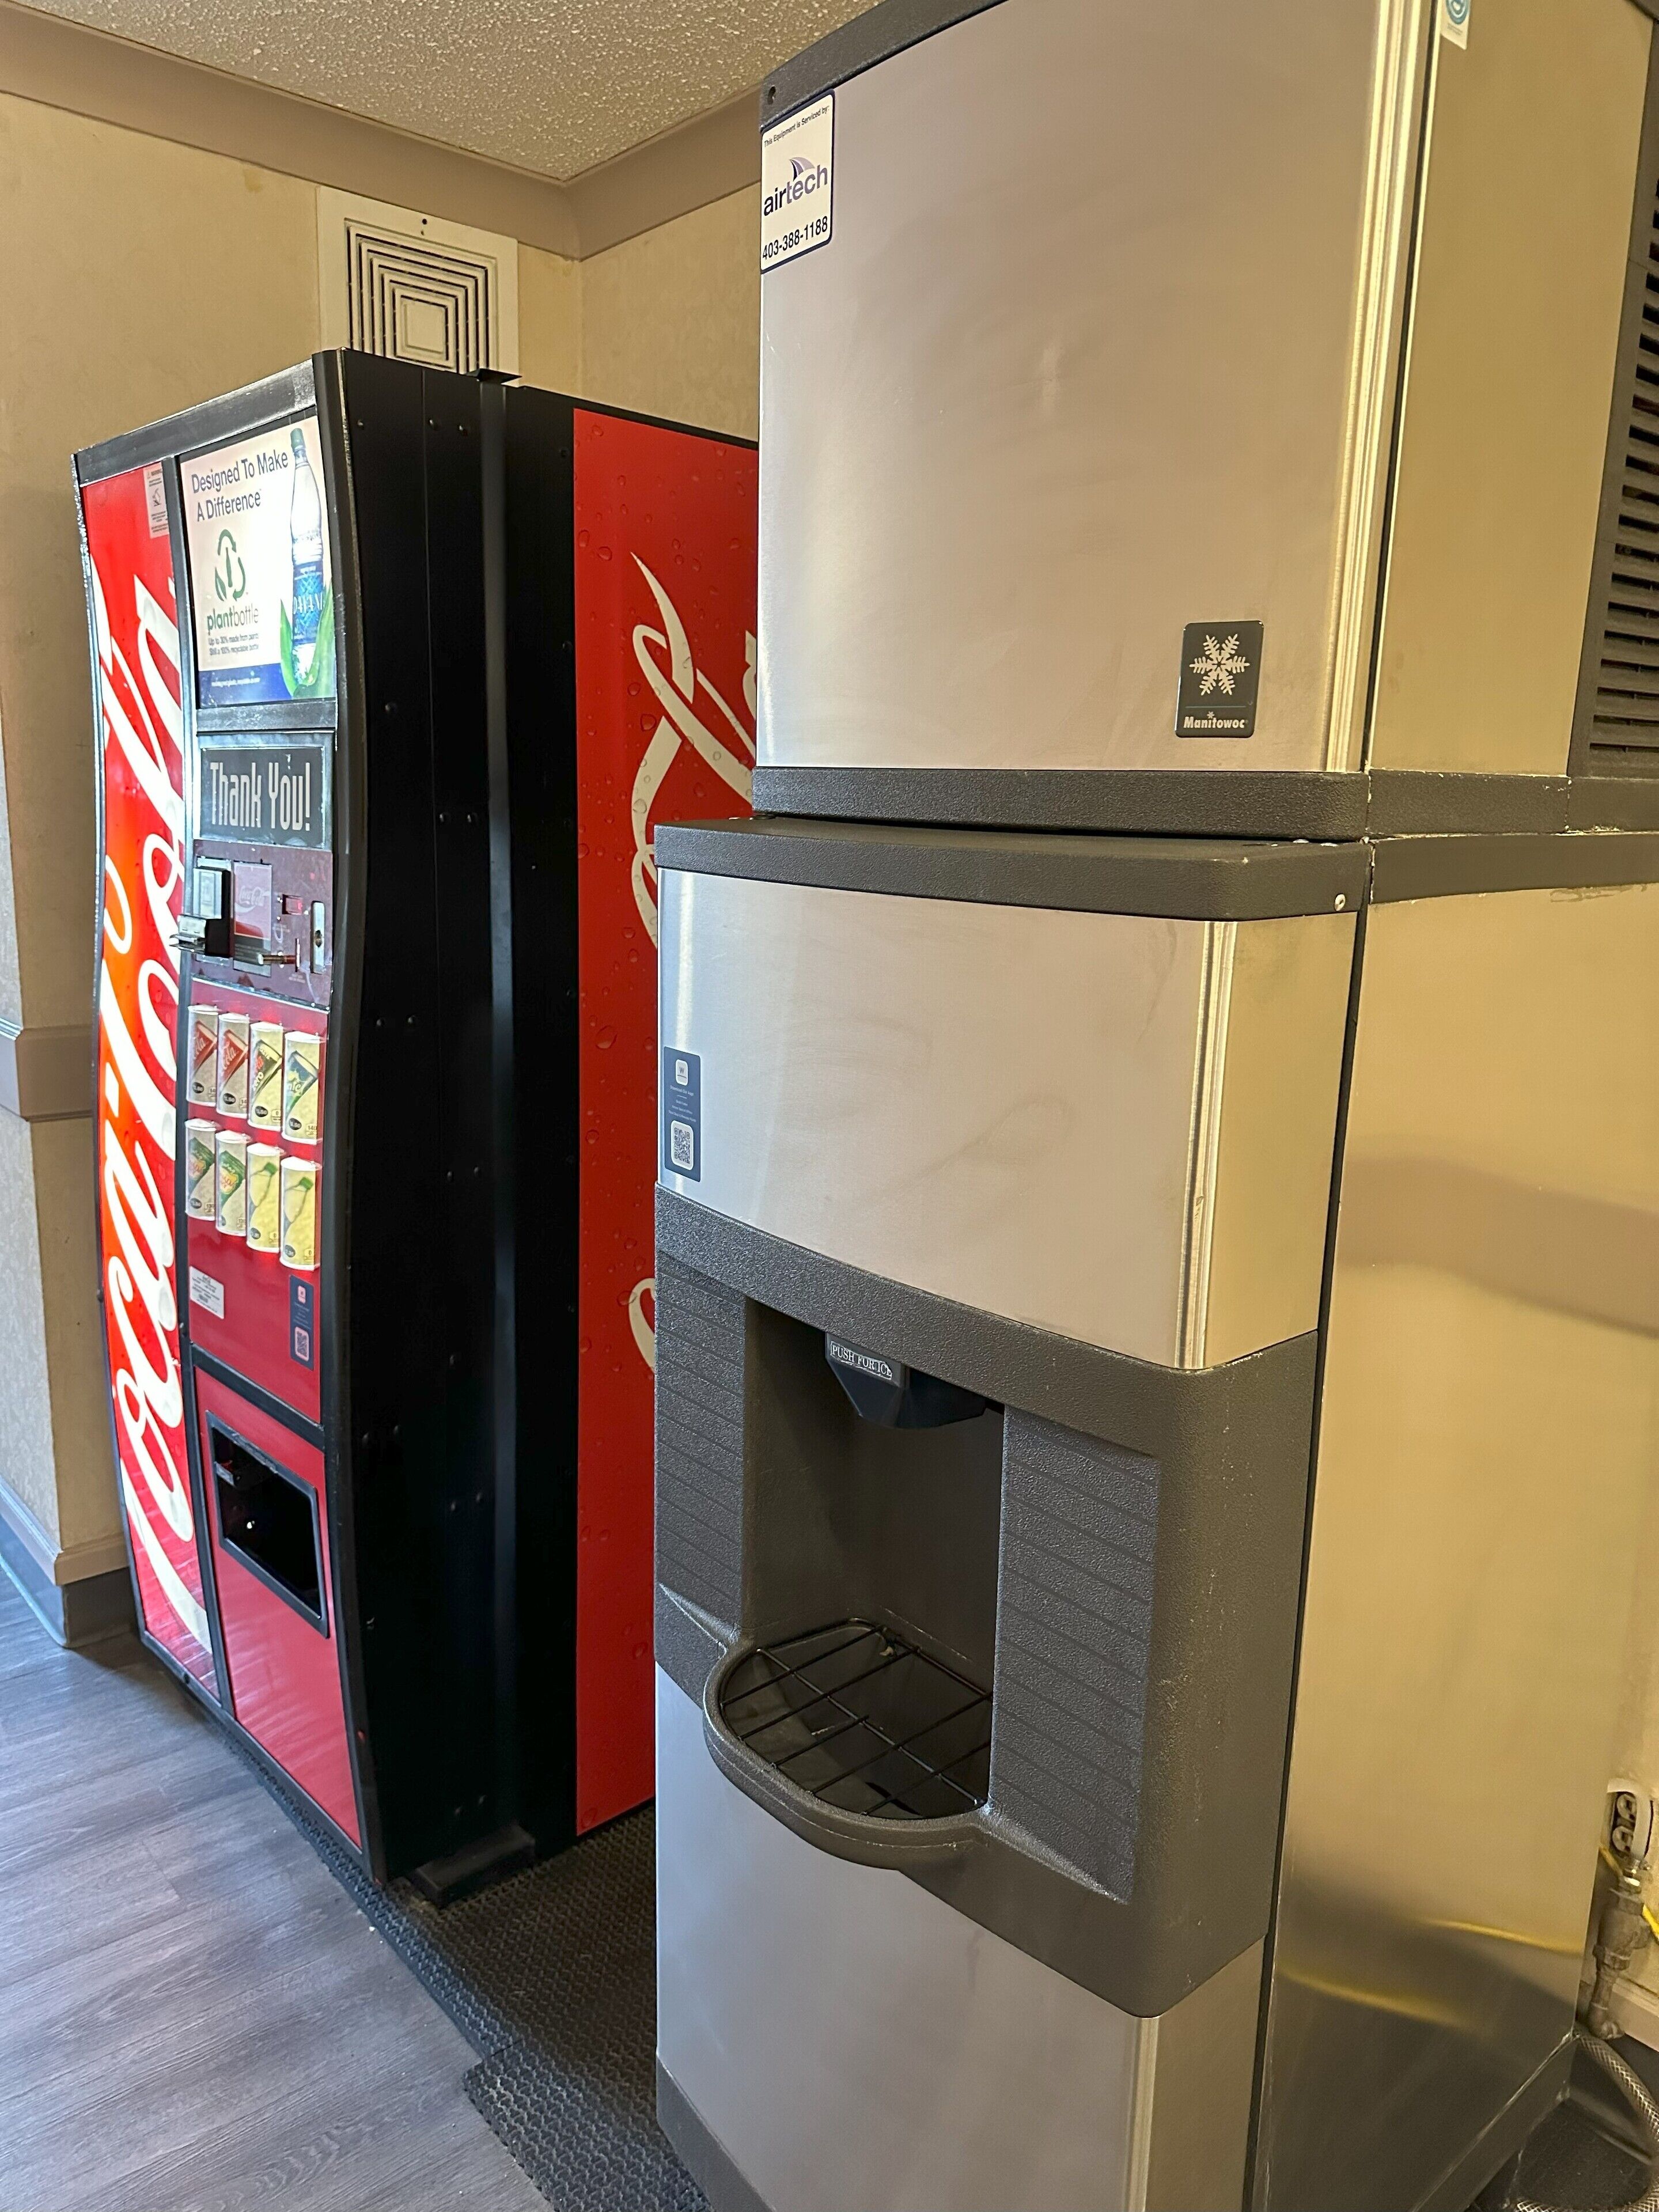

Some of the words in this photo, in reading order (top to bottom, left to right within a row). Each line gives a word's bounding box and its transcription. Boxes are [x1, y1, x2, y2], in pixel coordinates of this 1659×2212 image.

[764, 138, 772, 147] This
[773, 123, 796, 141] Equipment
[801, 108, 821, 126] Serviced
[764, 165, 828, 217] airtech
[763, 215, 828, 260] 403-388-1188
[191, 460, 240, 494] Designed
[241, 458, 255, 479] To
[256, 449, 289, 475] Make
[197, 502, 205, 522] A
[206, 491, 261, 519] Difference
[207, 603, 259, 635] plantbottle
[1183, 713, 1245, 729] Manitowoc
[210, 762, 262, 828] Thank
[268, 762, 310, 831] You!
[832, 1345, 855, 1363] PUSH
[858, 1355, 876, 1371] FOR
[877, 1362, 893, 1377] ICE
